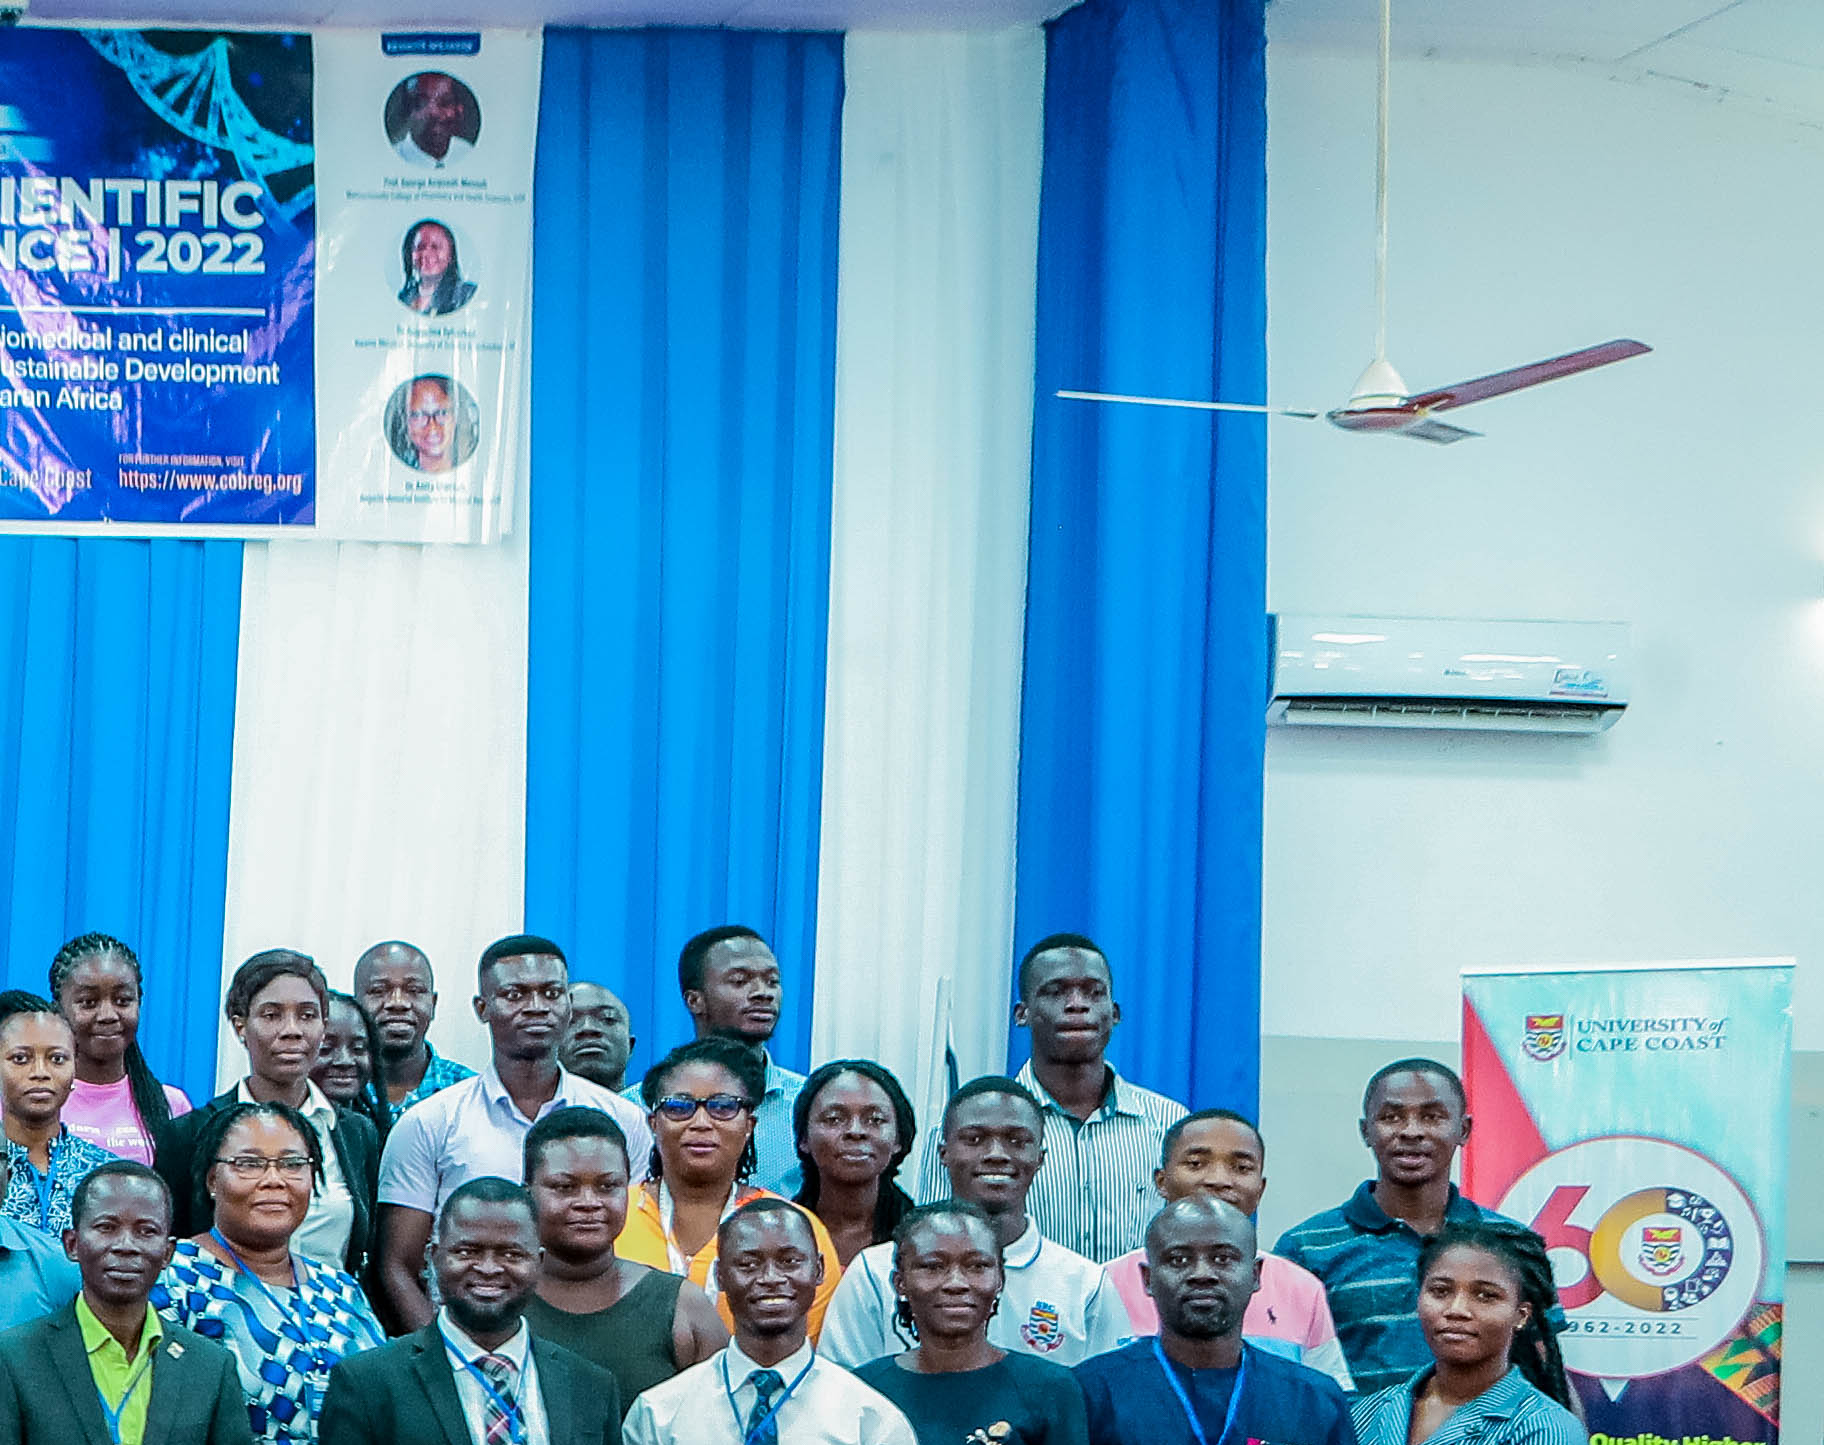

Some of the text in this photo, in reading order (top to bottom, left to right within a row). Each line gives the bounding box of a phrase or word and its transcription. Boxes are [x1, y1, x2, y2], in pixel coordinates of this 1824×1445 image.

[134, 230, 266, 274] 2022
[118, 327, 163, 353] and
[168, 327, 249, 353] clinical
[124, 358, 280, 388] Development
[56, 386, 123, 411] Africa
[43, 465, 92, 491] Coast
[119, 467, 303, 495] https://www.cobreg.org
[1576, 1016, 1729, 1035] UNIVERSITY of
[1576, 1035, 1727, 1052] CAPE COAST
[1530, 1185, 1733, 1313] 60
[1567, 1319, 1684, 1336] 962-2022
